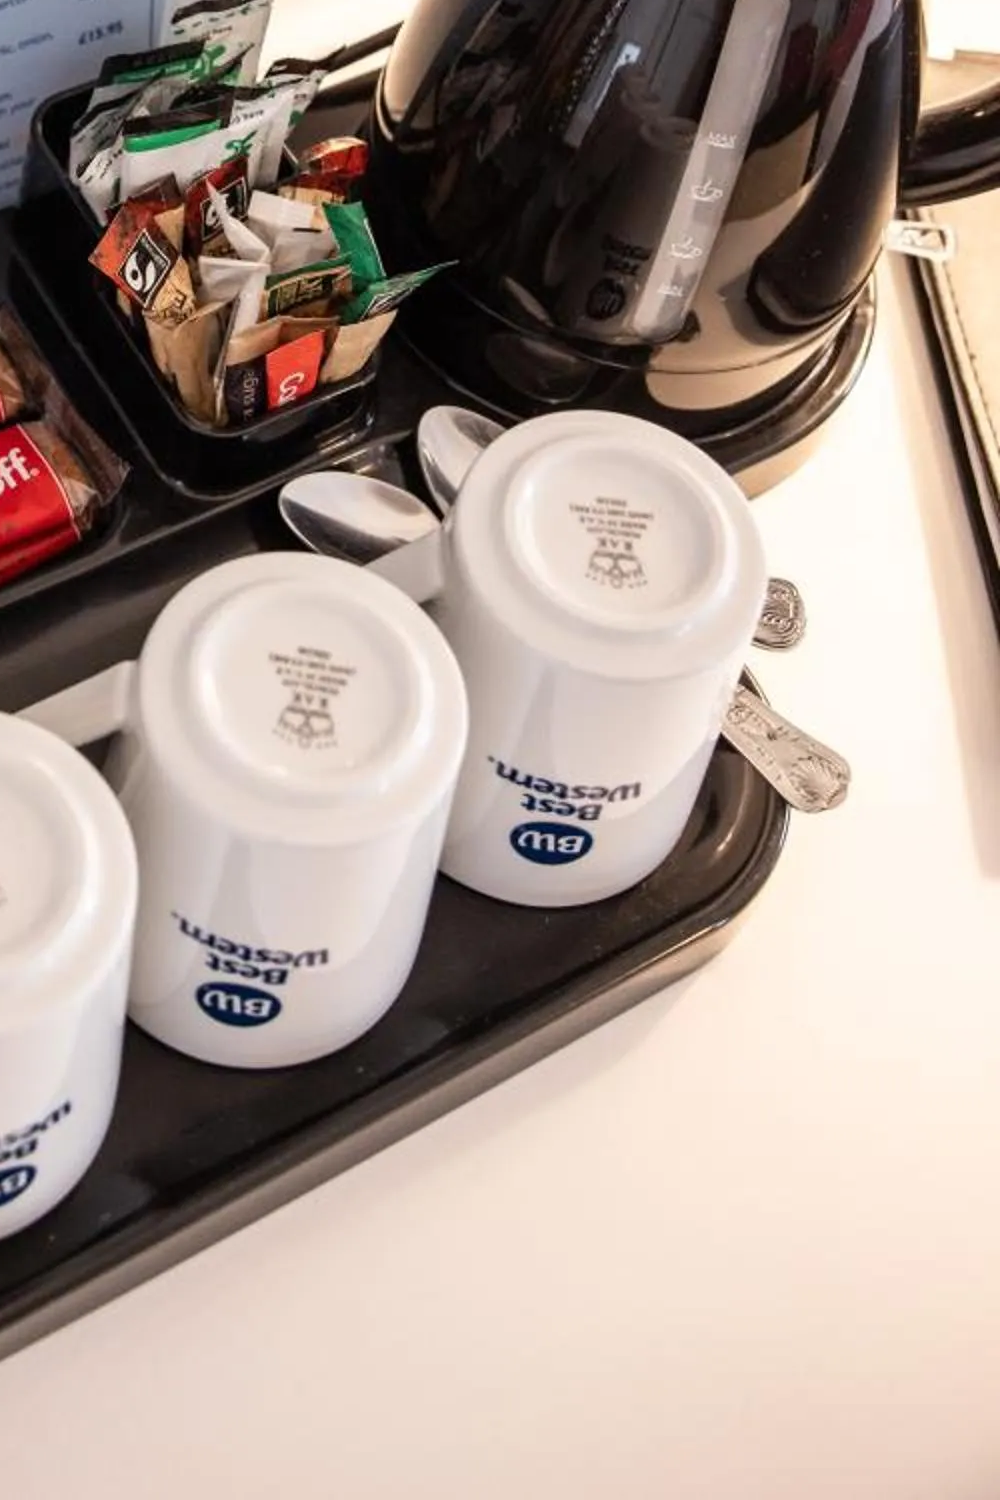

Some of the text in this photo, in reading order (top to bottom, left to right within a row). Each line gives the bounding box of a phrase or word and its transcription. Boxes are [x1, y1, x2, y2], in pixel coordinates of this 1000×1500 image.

[519, 793, 603, 821] Best
[514, 827, 588, 857] BW
[203, 952, 289, 986] Best
[199, 986, 276, 1021] BW
